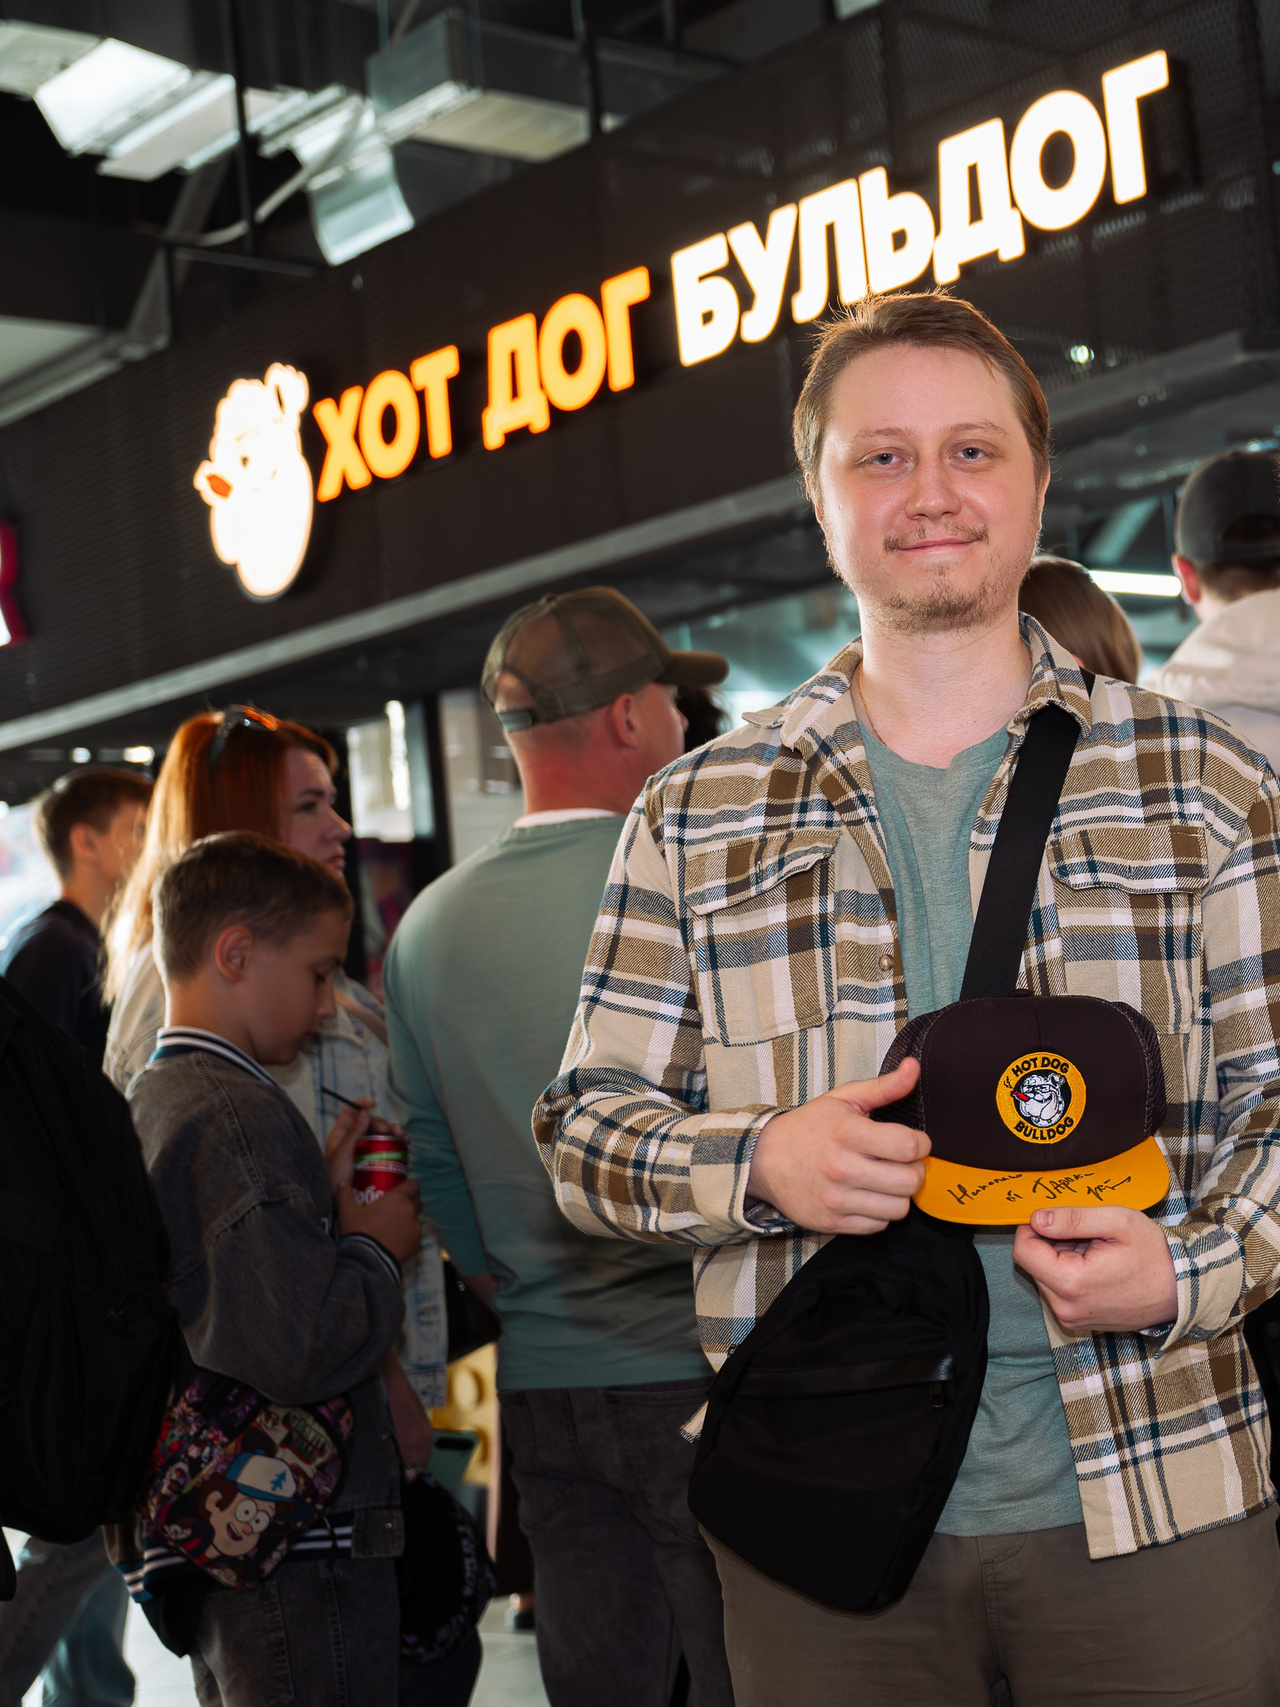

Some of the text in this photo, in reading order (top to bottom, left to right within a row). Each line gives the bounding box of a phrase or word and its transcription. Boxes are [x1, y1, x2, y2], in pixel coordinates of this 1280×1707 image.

[313, 50, 1169, 503] ХОТ ДОГ БУЛЬДОГ
[1011, 1057, 1069, 1077] HOT DOG
[1014, 1116, 1074, 1140] BULLDOG
